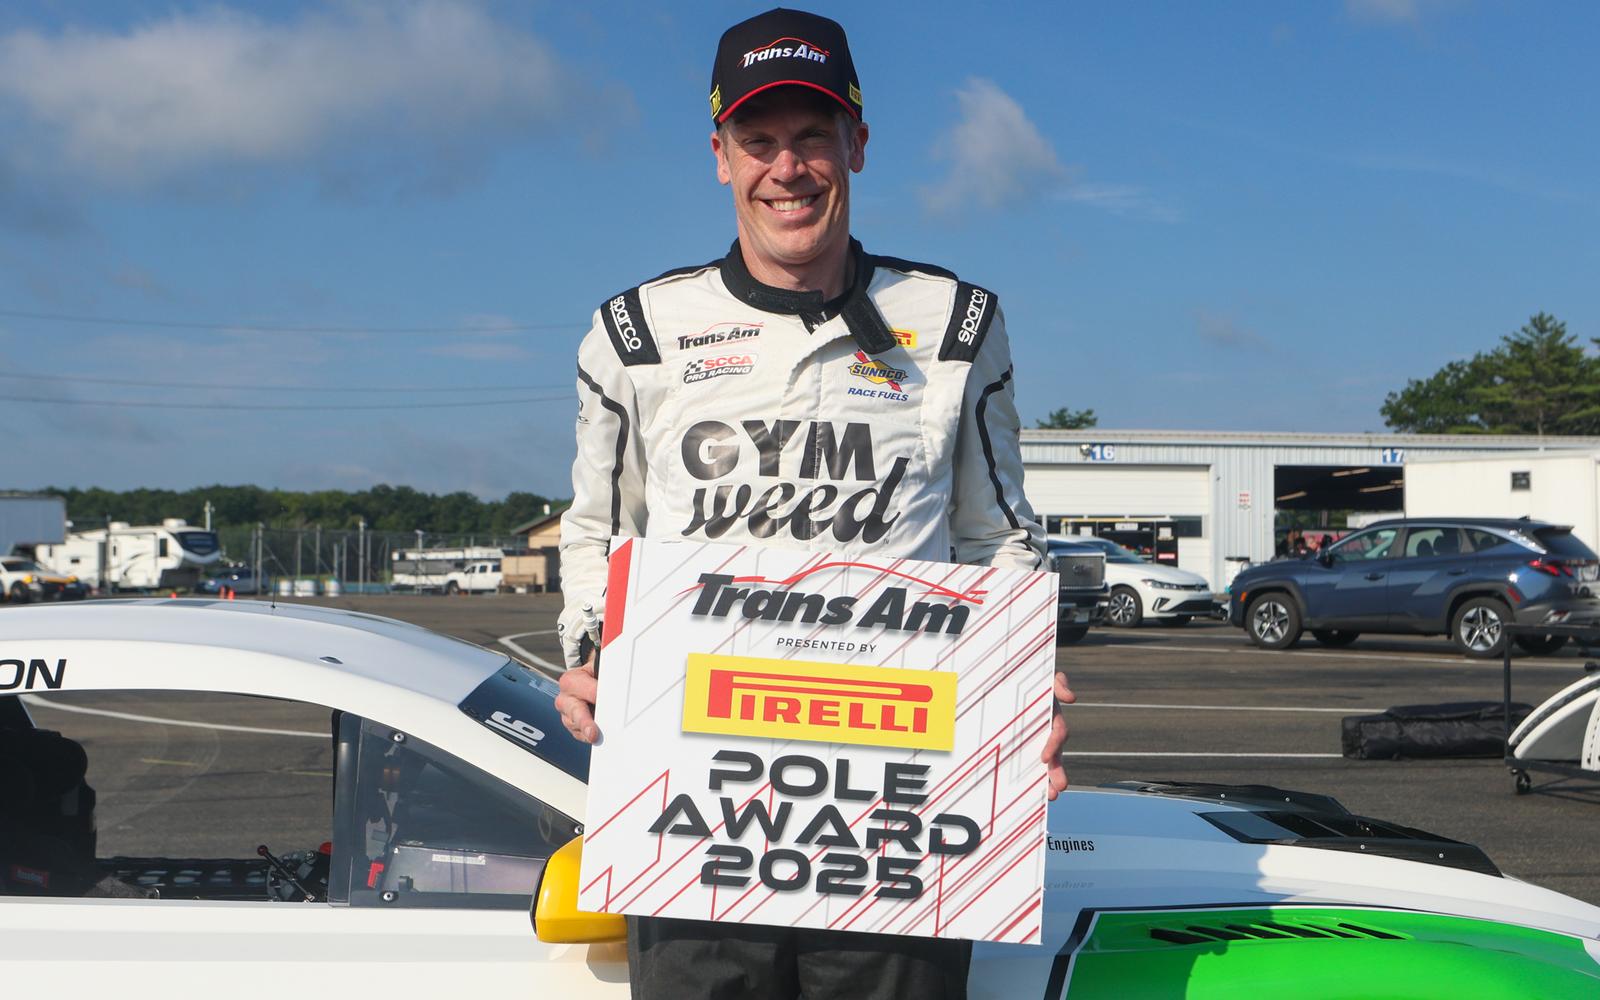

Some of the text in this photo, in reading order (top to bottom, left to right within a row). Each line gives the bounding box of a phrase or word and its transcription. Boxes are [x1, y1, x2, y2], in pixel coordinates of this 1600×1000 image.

[743, 44, 827, 69] Trans Am
[610, 295, 642, 352] sparco
[958, 288, 988, 346] sparco
[677, 331, 726, 351] Trans
[727, 326, 761, 341] Am
[685, 366, 752, 383] PRO RACING
[703, 355, 753, 369] SCCA
[852, 364, 904, 381] SUNOCO
[848, 387, 909, 402] RACE FUELS
[681, 419, 877, 481] GYM
[1092, 444, 1115, 460] 16
[1382, 447, 1404, 463] 17
[681, 457, 910, 544] weed
[691, 573, 970, 634] Trans Am
[777, 637, 877, 653] PRESENTED BY
[706, 669, 934, 734] PIRELLI
[708, 750, 931, 803] POLE
[647, 793, 982, 855] AWARD
[1047, 836, 1095, 853] Engines
[701, 844, 924, 900] 2025
